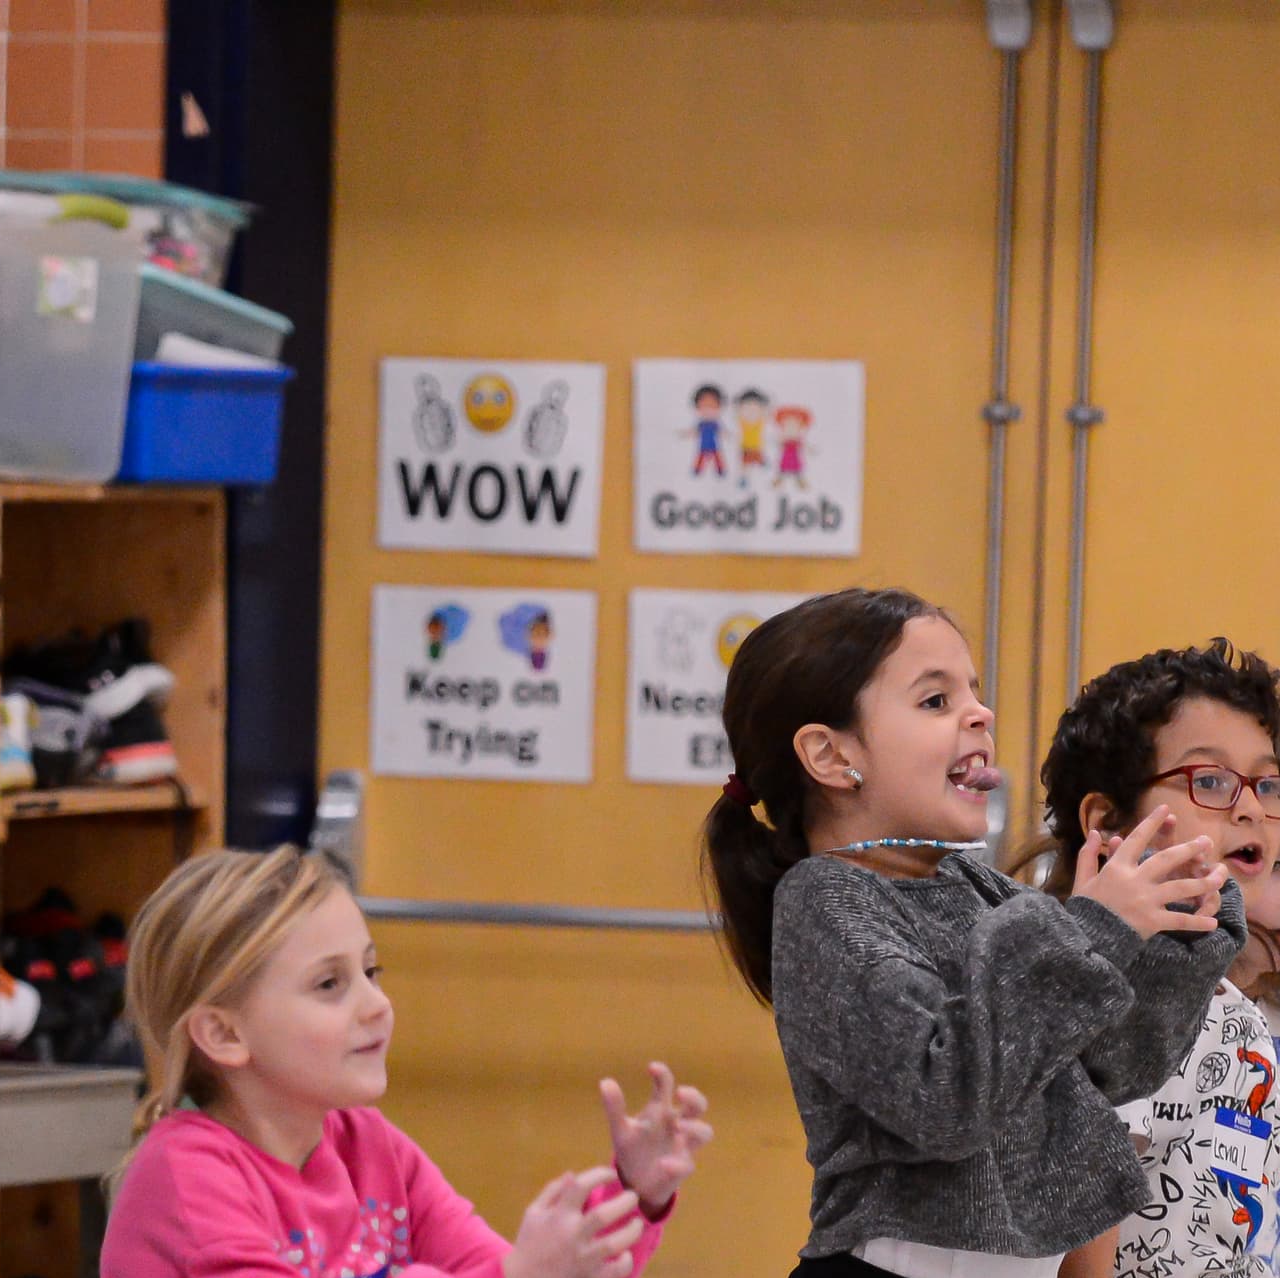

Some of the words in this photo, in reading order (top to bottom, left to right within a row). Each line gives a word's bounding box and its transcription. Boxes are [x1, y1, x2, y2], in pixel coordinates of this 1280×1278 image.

[397, 459, 581, 524] WOW
[650, 492, 757, 532] Good
[772, 496, 843, 532] Job
[405, 667, 499, 708] Keep
[512, 681, 560, 706] on
[640, 681, 725, 718] Nee
[424, 719, 540, 765] Trying
[1188, 1168, 1218, 1237] SENSE
